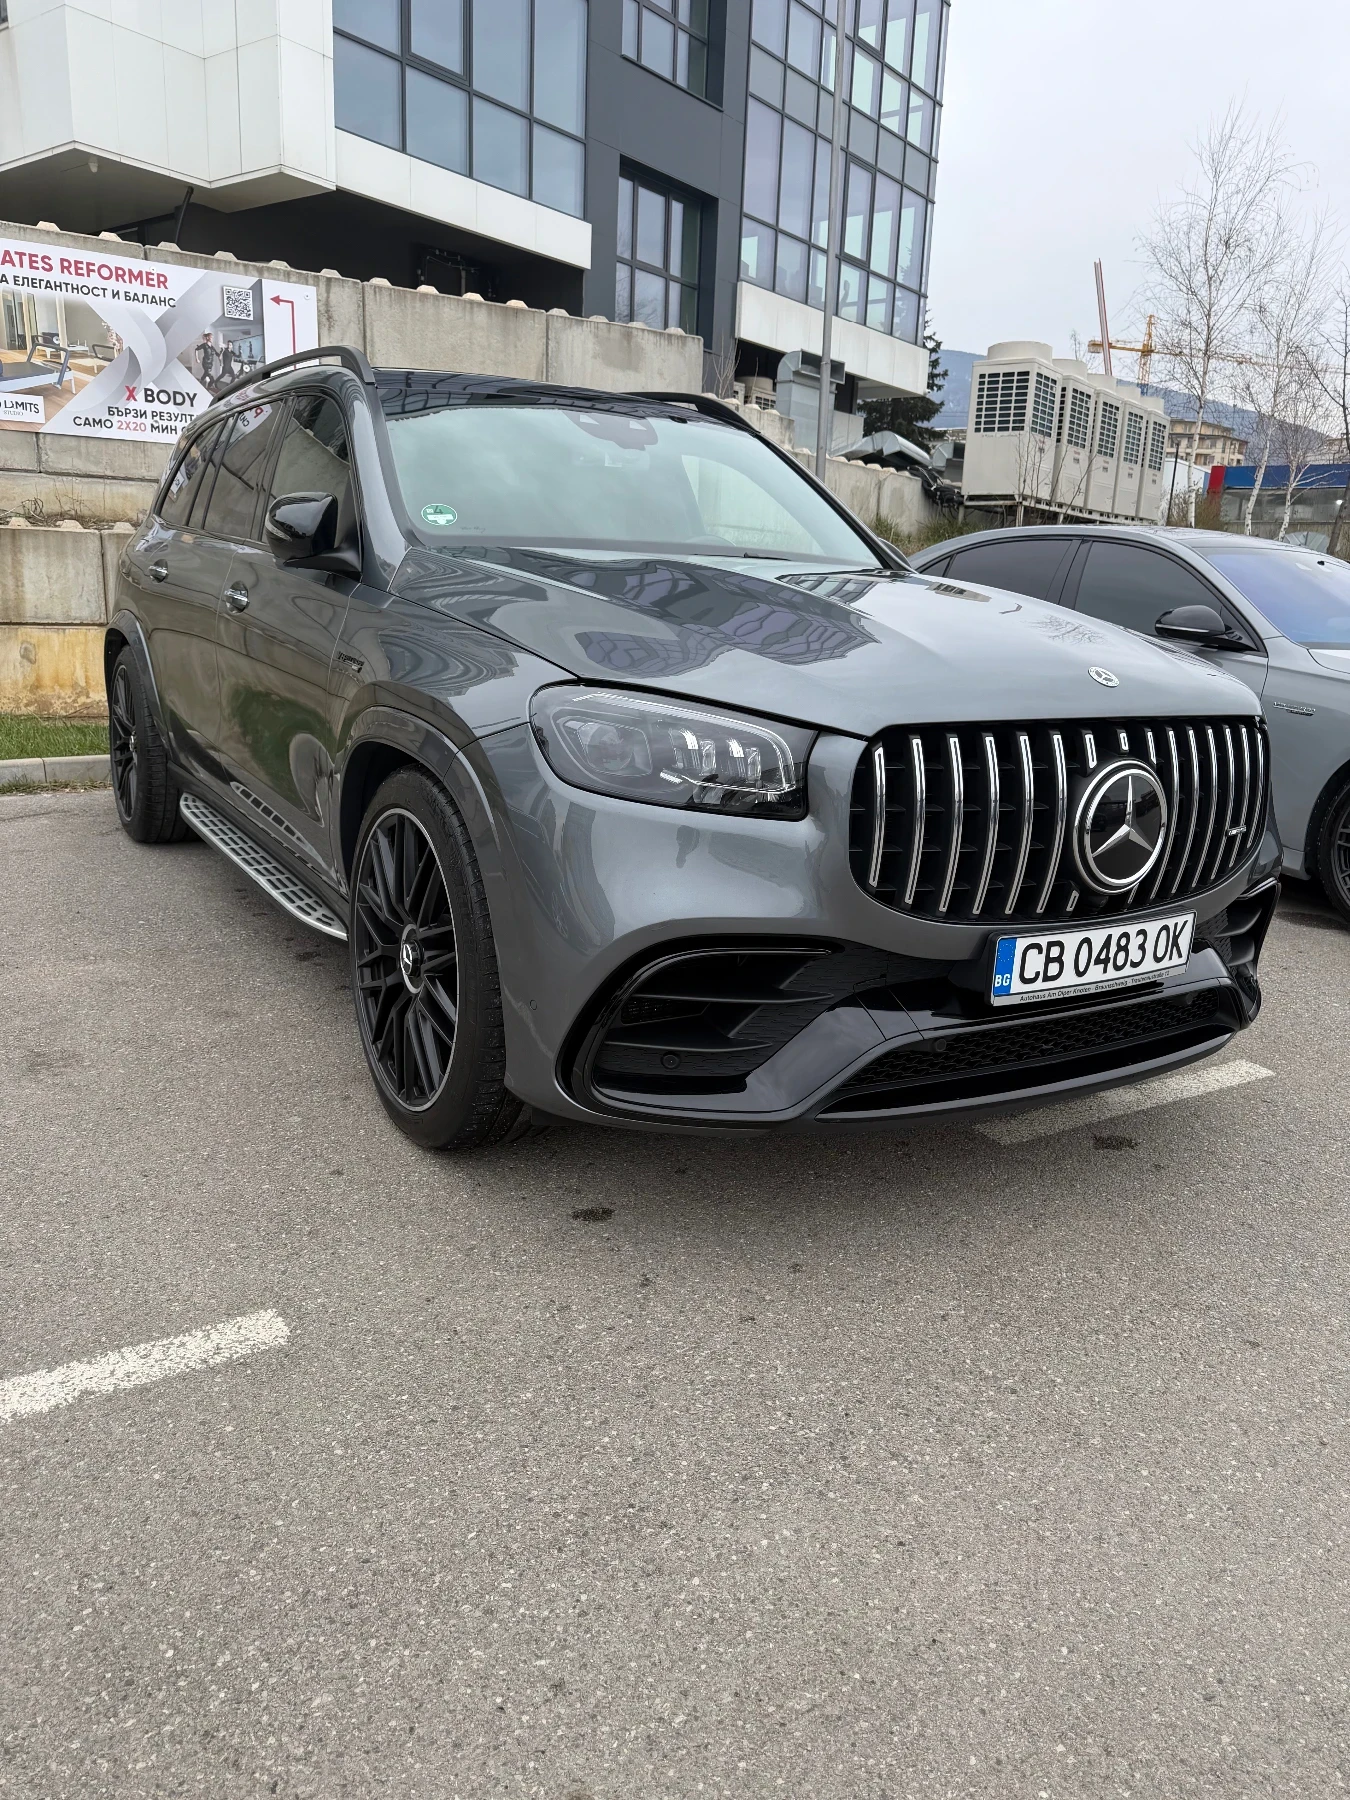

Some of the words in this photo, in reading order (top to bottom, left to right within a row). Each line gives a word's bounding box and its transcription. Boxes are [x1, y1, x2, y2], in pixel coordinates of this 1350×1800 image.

[59, 257, 169, 290] REFORMER
[13, 274, 108, 298] ЕЛЕГАНТНОСТ
[111, 288, 121, 300] И
[124, 290, 176, 308] БАЛАНС
[125, 385, 138, 402] X
[143, 387, 198, 408] BODY
[72, 415, 114, 429] САМО
[150, 422, 178, 435] МИН
[107, 405, 148, 420] БЪРЗИ
[150, 410, 199, 424] РЕЗУЛТ
[1019, 939, 1065, 985] CB
[1073, 928, 1148, 978] 0483
[1152, 919, 1189, 964] OK
[994, 973, 1012, 988] BG
